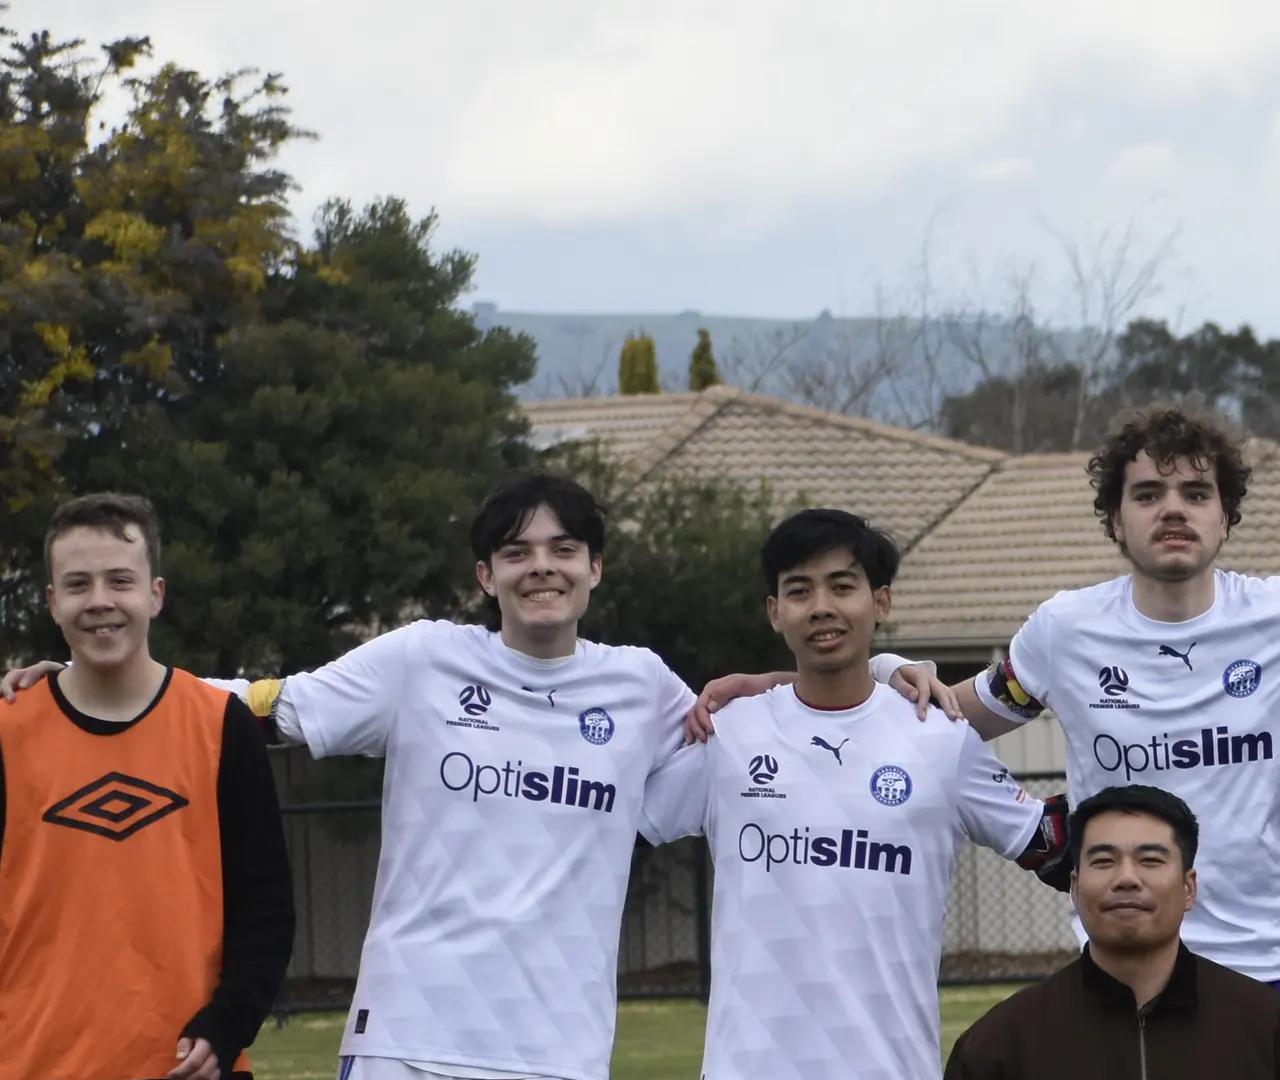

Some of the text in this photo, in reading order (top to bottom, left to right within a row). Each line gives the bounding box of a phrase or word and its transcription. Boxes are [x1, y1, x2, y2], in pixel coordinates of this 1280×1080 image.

[1093, 726, 1273, 781] Optislim
[440, 752, 616, 813] Optislim
[738, 822, 912, 875] Optislim
